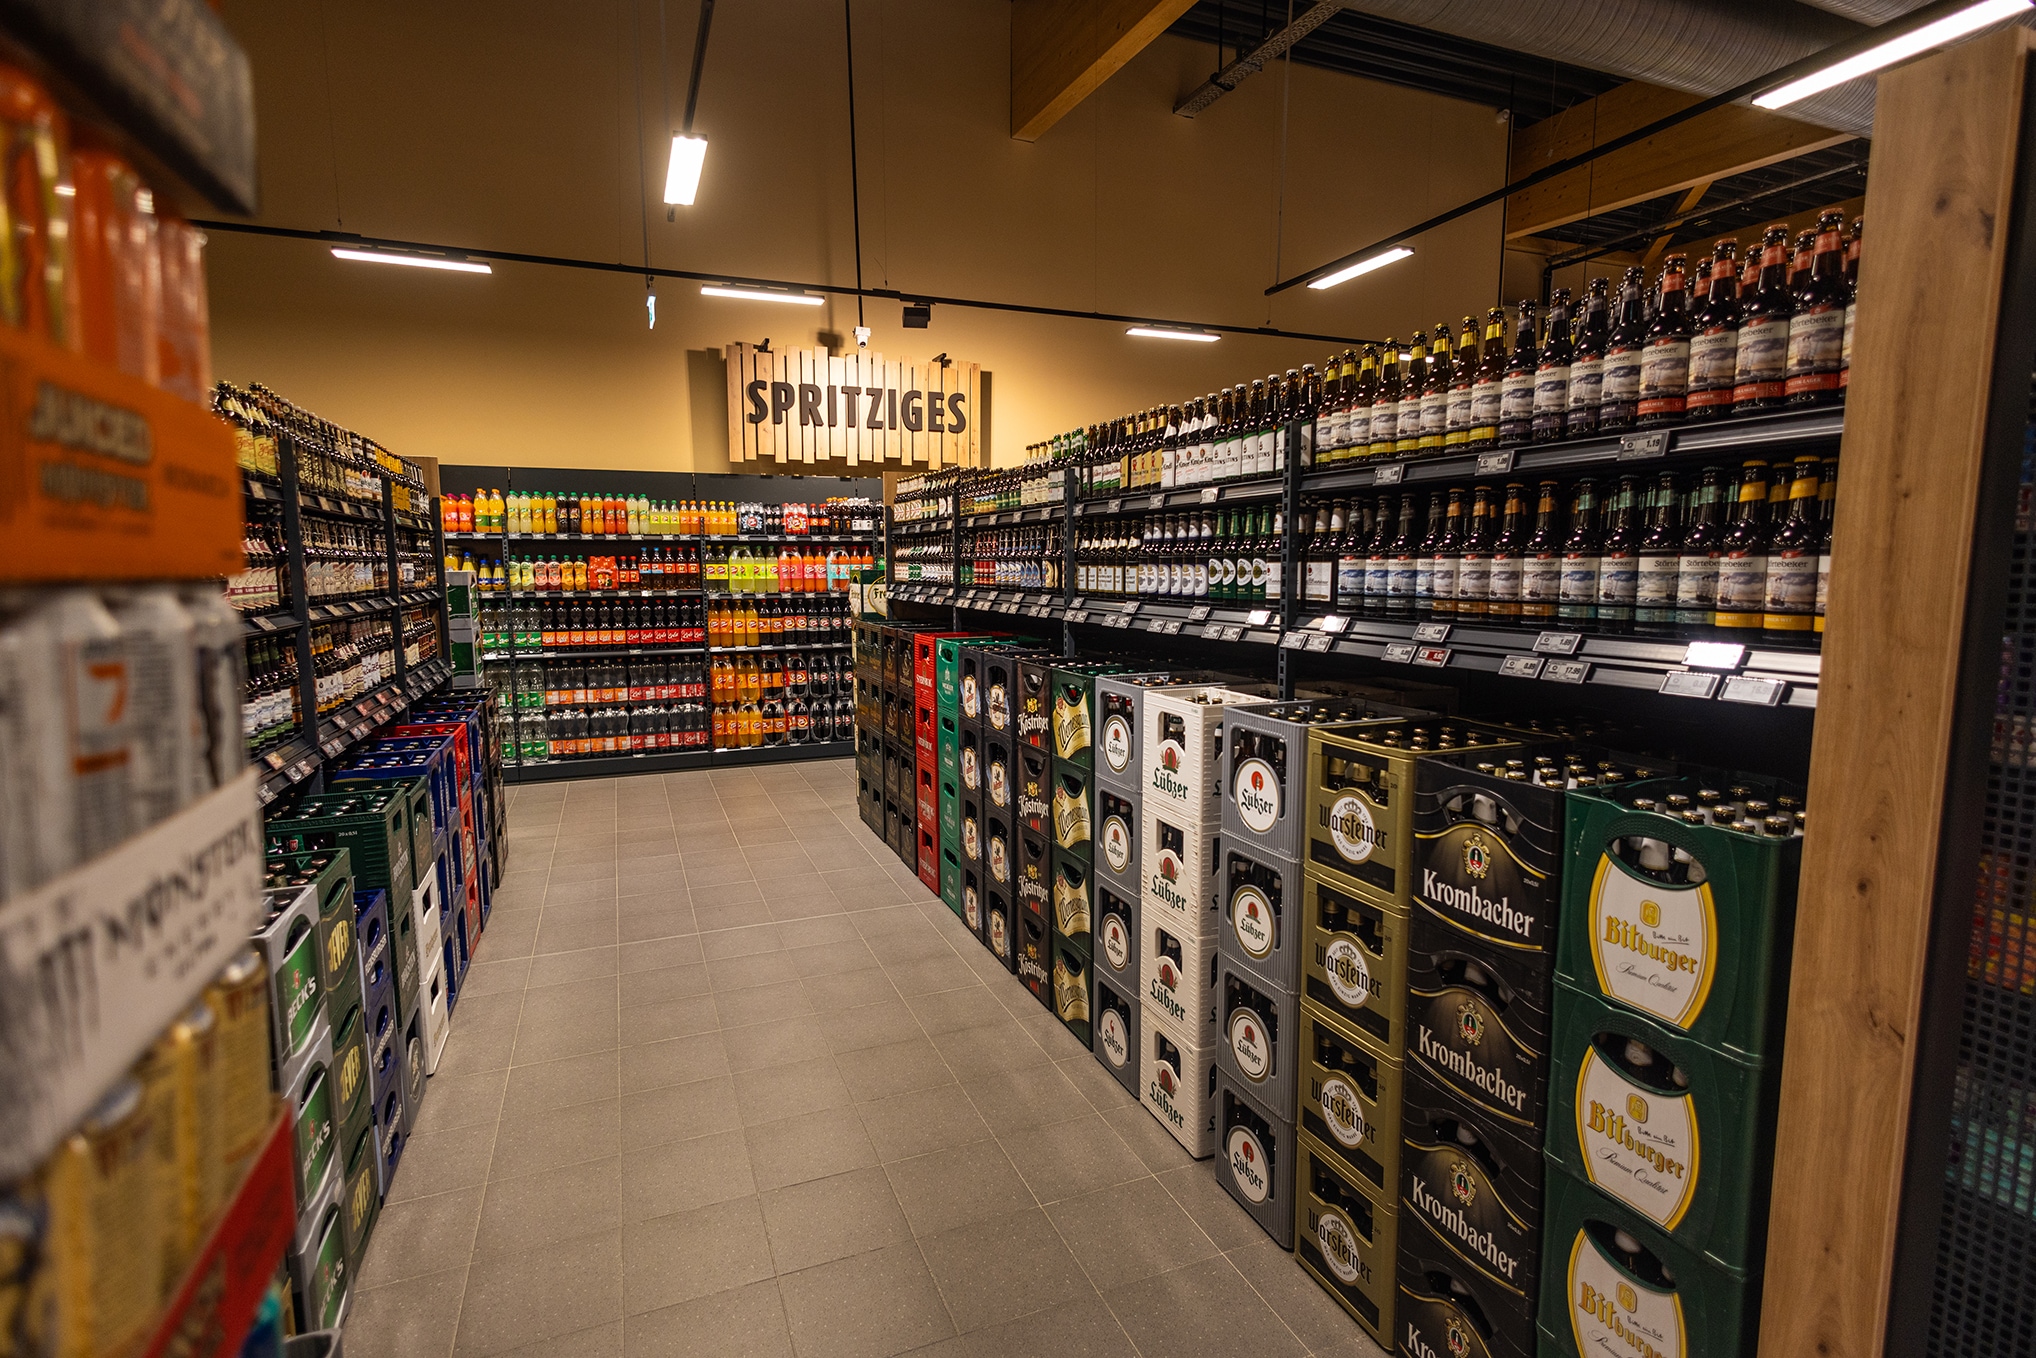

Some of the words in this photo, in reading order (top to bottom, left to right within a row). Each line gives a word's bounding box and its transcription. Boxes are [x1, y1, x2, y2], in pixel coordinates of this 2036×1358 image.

[747, 380, 967, 433] SPRITZIGES
[1646, 439, 1660, 448] 1.19
[1152, 767, 1188, 800] Lübzer
[1241, 788, 1274, 815] Lübzer
[1319, 803, 1387, 850] Warsteiner
[1151, 876, 1187, 912] Lübzer
[1423, 868, 1534, 938] Krombacher
[328, 919, 350, 974] JEVER
[1240, 920, 1266, 942] Lübzer
[1603, 915, 1698, 975] Bitburger
[1315, 942, 1382, 1000] Warsteiner
[287, 976, 317, 1028] BECK'S
[1150, 978, 1186, 1022] Lübzer
[340, 1045, 360, 1105] JEVER
[1237, 1040, 1263, 1067] Lübzer
[1418, 1024, 1526, 1112] Krombacher
[1150, 1079, 1184, 1129] Lübzer
[1311, 1076, 1377, 1145] Warsteiner
[302, 1120, 331, 1184] BECK'S
[1586, 1100, 1685, 1179] Bitburger
[1233, 1154, 1264, 1191] Lübzer
[352, 1167, 372, 1233] JEVER
[1307, 1207, 1372, 1285] Warsteiner
[1412, 1175, 1518, 1280] Krombacher
